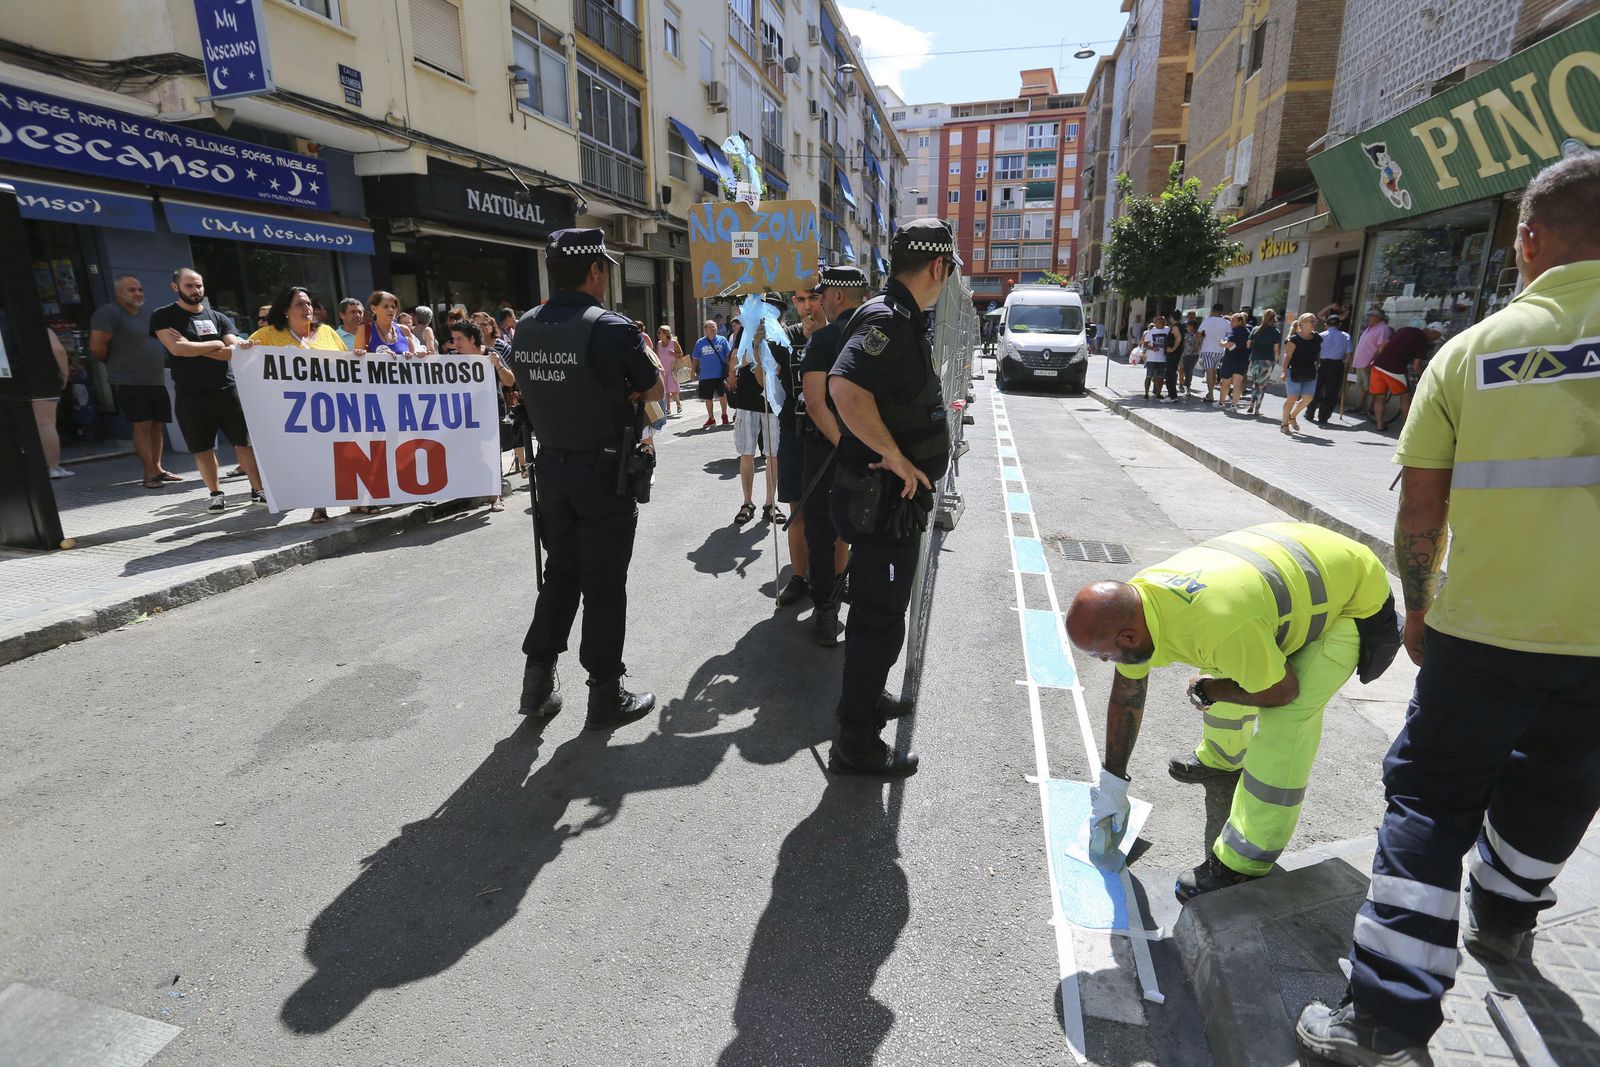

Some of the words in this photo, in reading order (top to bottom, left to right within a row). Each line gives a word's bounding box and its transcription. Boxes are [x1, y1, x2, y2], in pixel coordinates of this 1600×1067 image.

[214, 8, 238, 32] My
[206, 38, 257, 61] descanso
[16, 96, 75, 123] BASES,
[77, 110, 117, 131] ROPA
[121, 121, 141, 136] DE
[185, 136, 239, 159] SILLONES,
[466, 188, 545, 224] NATURAL
[689, 203, 741, 244] NO
[752, 208, 821, 244] ZONA
[738, 247, 750, 256] NO
[263, 354, 363, 383] ALCALDE
[367, 360, 485, 384] MENTIROSO
[514, 349, 548, 364] POLICÍA
[550, 352, 577, 365] LOCAL
[529, 367, 566, 382] MÁLAGA
[283, 391, 386, 433] ZONA
[398, 392, 481, 432] AZUL
[333, 438, 448, 500] NO
